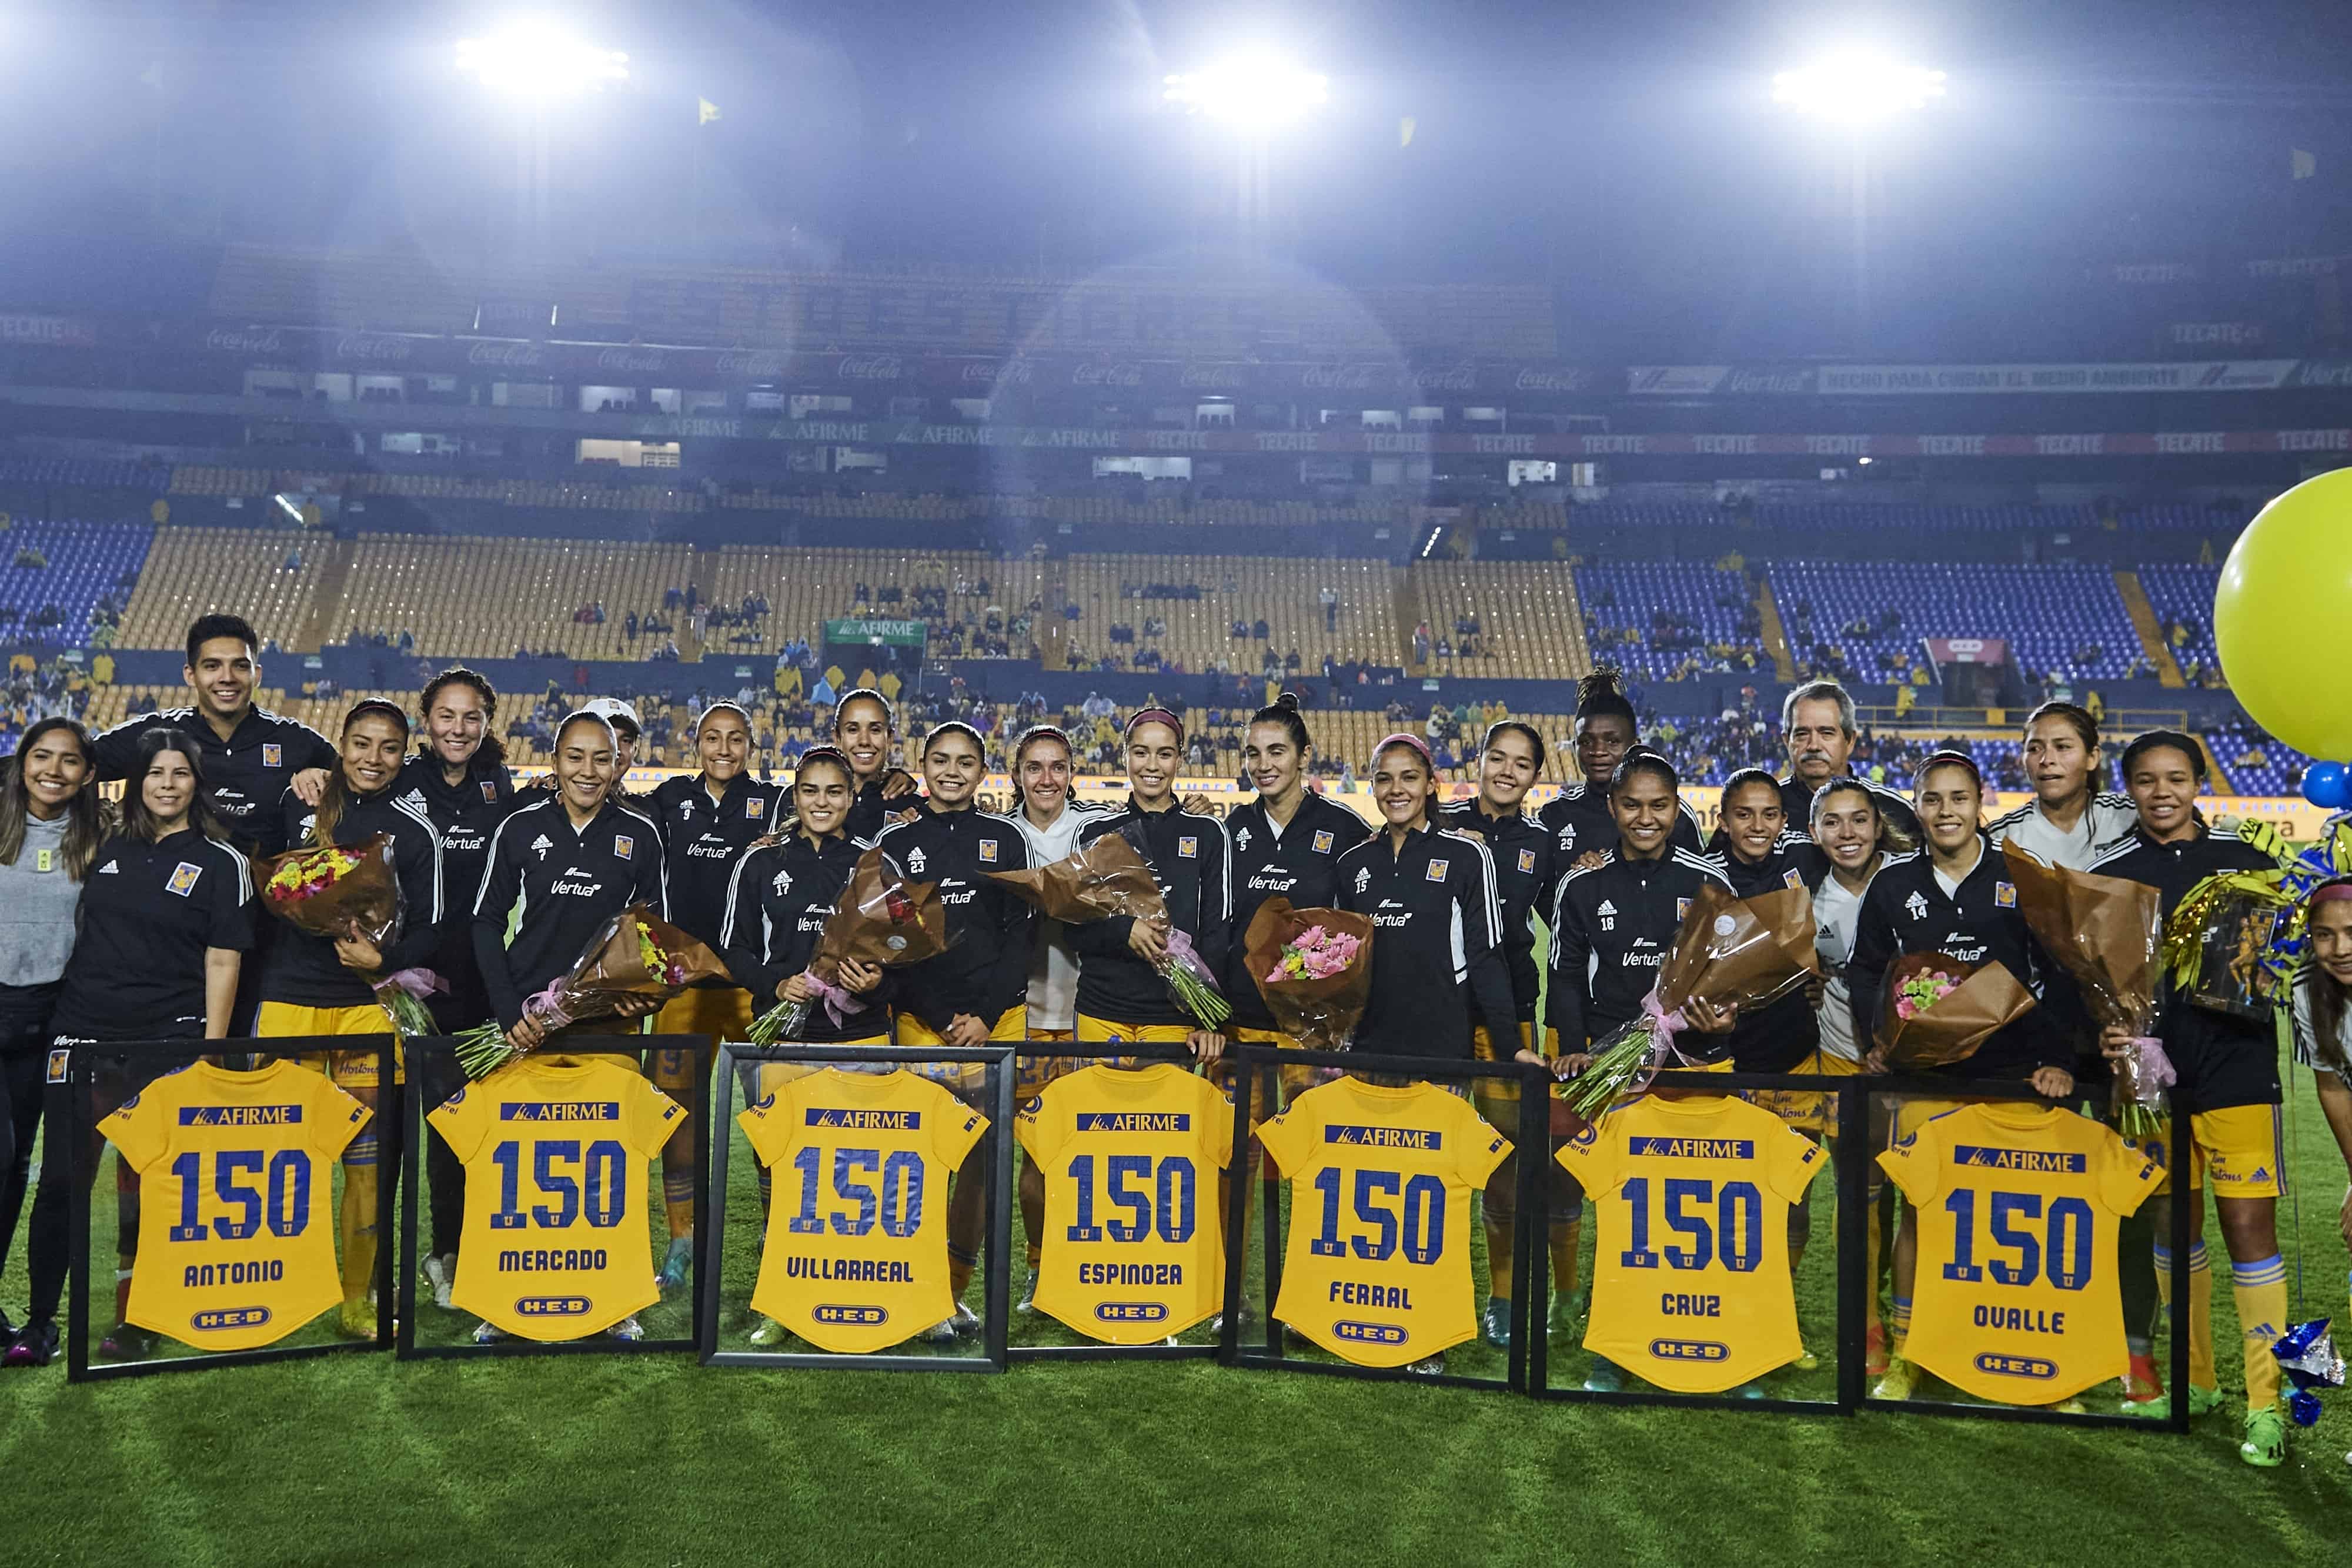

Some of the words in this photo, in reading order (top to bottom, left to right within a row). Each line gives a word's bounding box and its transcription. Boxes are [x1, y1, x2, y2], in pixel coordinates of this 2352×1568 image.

[0, 316, 62, 339] ECATE
[671, 419, 742, 437] AFIRME
[794, 424, 869, 442] AFIRME
[921, 427, 994, 446] AFIRME
[1045, 429, 1120, 449] AFIRME
[1145, 431, 1209, 449] TECATE
[1254, 432, 1319, 450] TECATE
[1362, 433, 1429, 452] TECATE
[1472, 434, 1536, 453] TECATE
[1581, 435, 1647, 453] TECATE
[1692, 435, 1758, 453] TECATE
[1805, 434, 1872, 454] TECATE
[1918, 435, 1987, 455] TECATE
[2034, 434, 2105, 454] TECATE
[2153, 432, 2226, 453] TECATE
[2276, 429, 2350, 451] TECATE
[858, 623, 913, 636] AFIRME
[683, 809, 691, 821] 9
[300, 828, 310, 840] 6
[440, 836, 481, 849] Vertua
[687, 843, 726, 858] Vertua
[1240, 840, 1247, 852] 5
[1560, 838, 1573, 851] 29
[539, 848, 546, 861] 7
[910, 861, 925, 874] 23
[551, 881, 594, 897] Vertua
[772, 878, 794, 886] adidas
[776, 883, 790, 897] 17
[1248, 875, 1290, 891] Vertua
[1356, 880, 1368, 894] 15
[1910, 905, 1928, 921] 14
[1601, 917, 1615, 931] 18
[1623, 952, 1661, 967] Vertua
[218, 1106, 290, 1125] AFIRME
[440, 1103, 459, 1116] erel
[538, 1104, 607, 1120] AFIRME
[749, 1106, 767, 1121] erel
[841, 1111, 909, 1129] AFIRME
[1112, 1115, 1179, 1131] AFIRME
[1361, 1129, 1430, 1149] AFIRME
[1668, 1140, 1742, 1159] AFIRME
[1890, 1144, 1911, 1159] erel
[1995, 1148, 2073, 1172] AFIRME
[490, 1141, 626, 1229] 150
[789, 1146, 924, 1237] 150
[170, 1149, 311, 1242] 150
[1067, 1155, 1195, 1243] 150
[1311, 1167, 1446, 1265] 150
[1621, 1177, 1762, 1272] 150
[1943, 1188, 2093, 1290] 150
[499, 1249, 607, 1271] MERCADO
[184, 1260, 283, 1287] ANTONIO
[787, 1257, 913, 1283] VILLARREAL
[1080, 1263, 1182, 1285] ESPINOZA
[1329, 1281, 1412, 1310] FERRAL
[524, 1300, 584, 1312] H-E-B
[1104, 1307, 1161, 1318] H-E-B
[1662, 1293, 1720, 1317] CRUZ
[201, 1310, 264, 1326] H-E-B
[821, 1309, 880, 1322] H-E-B
[1974, 1305, 2065, 1334] OVALLE
[1342, 1325, 1400, 1340] H-E-B
[1659, 1344, 1721, 1358] H-E-B
[1984, 1358, 2049, 1374] H-E-B
